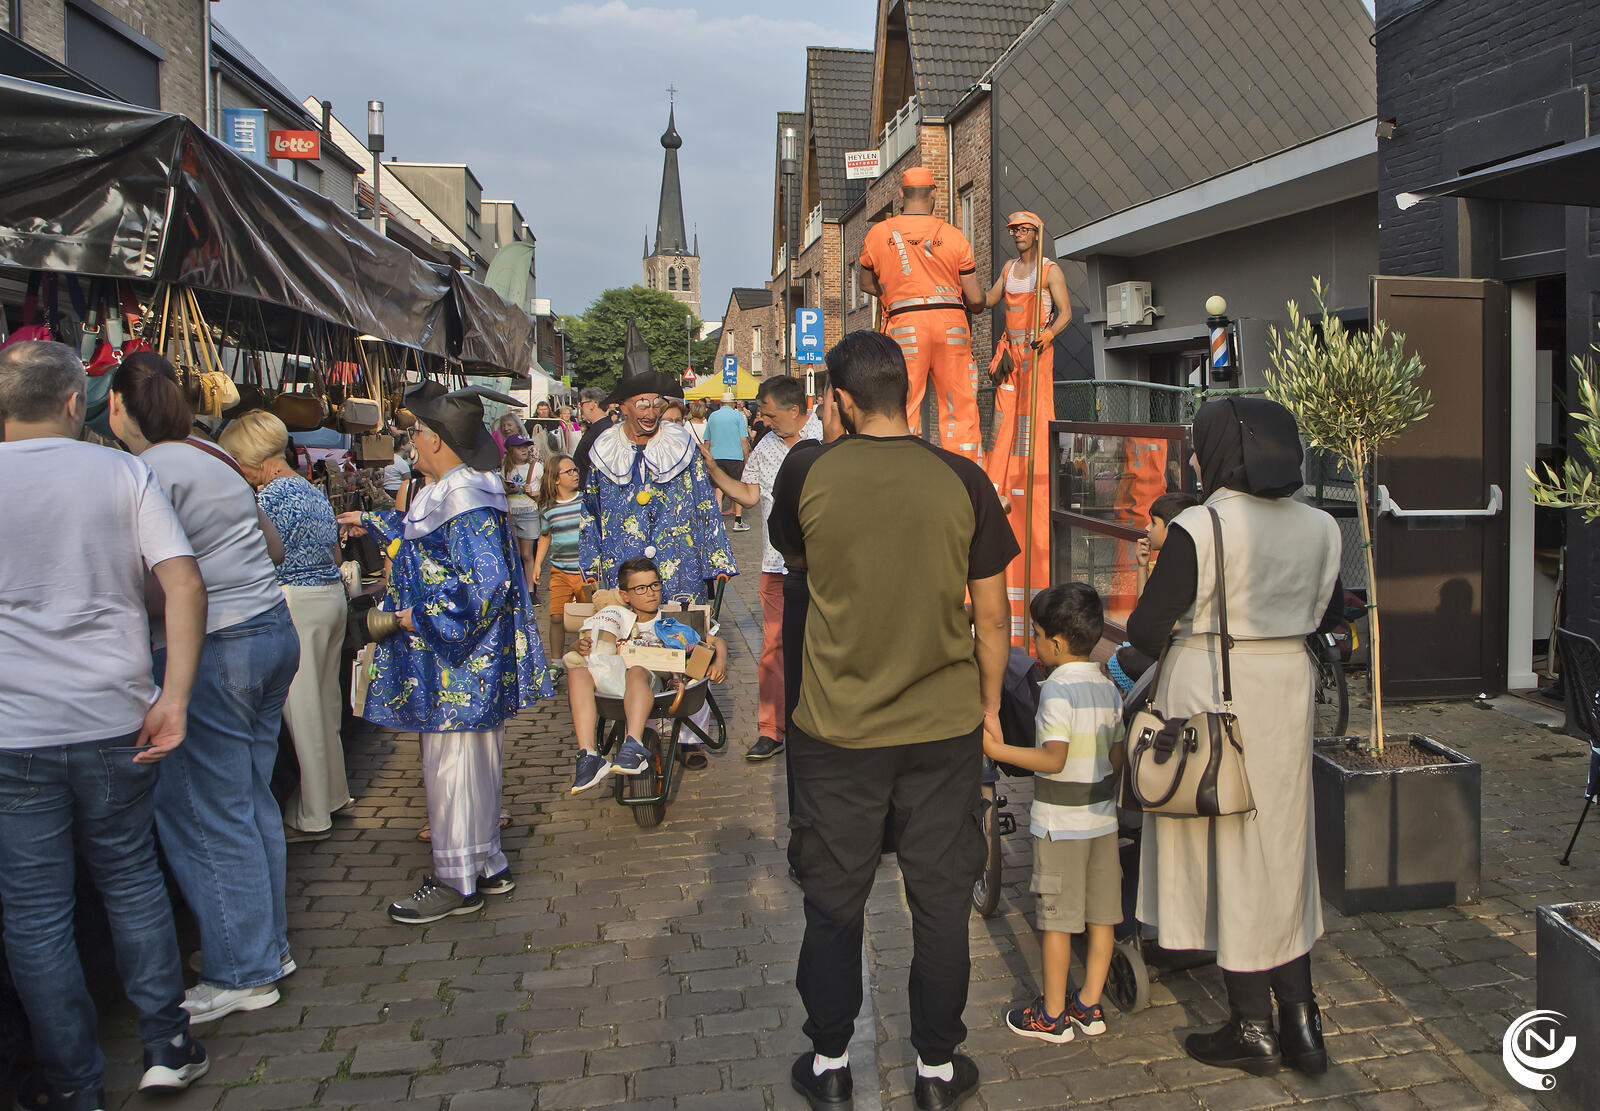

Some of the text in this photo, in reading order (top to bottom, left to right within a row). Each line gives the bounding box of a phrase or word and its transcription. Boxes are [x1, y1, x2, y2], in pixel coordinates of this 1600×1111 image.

[234, 117, 256, 145] HET
[848, 153, 877, 161] HEYLEN
[802, 311, 817, 332] P
[807, 352, 815, 361] 15
[725, 358, 734, 370] P
